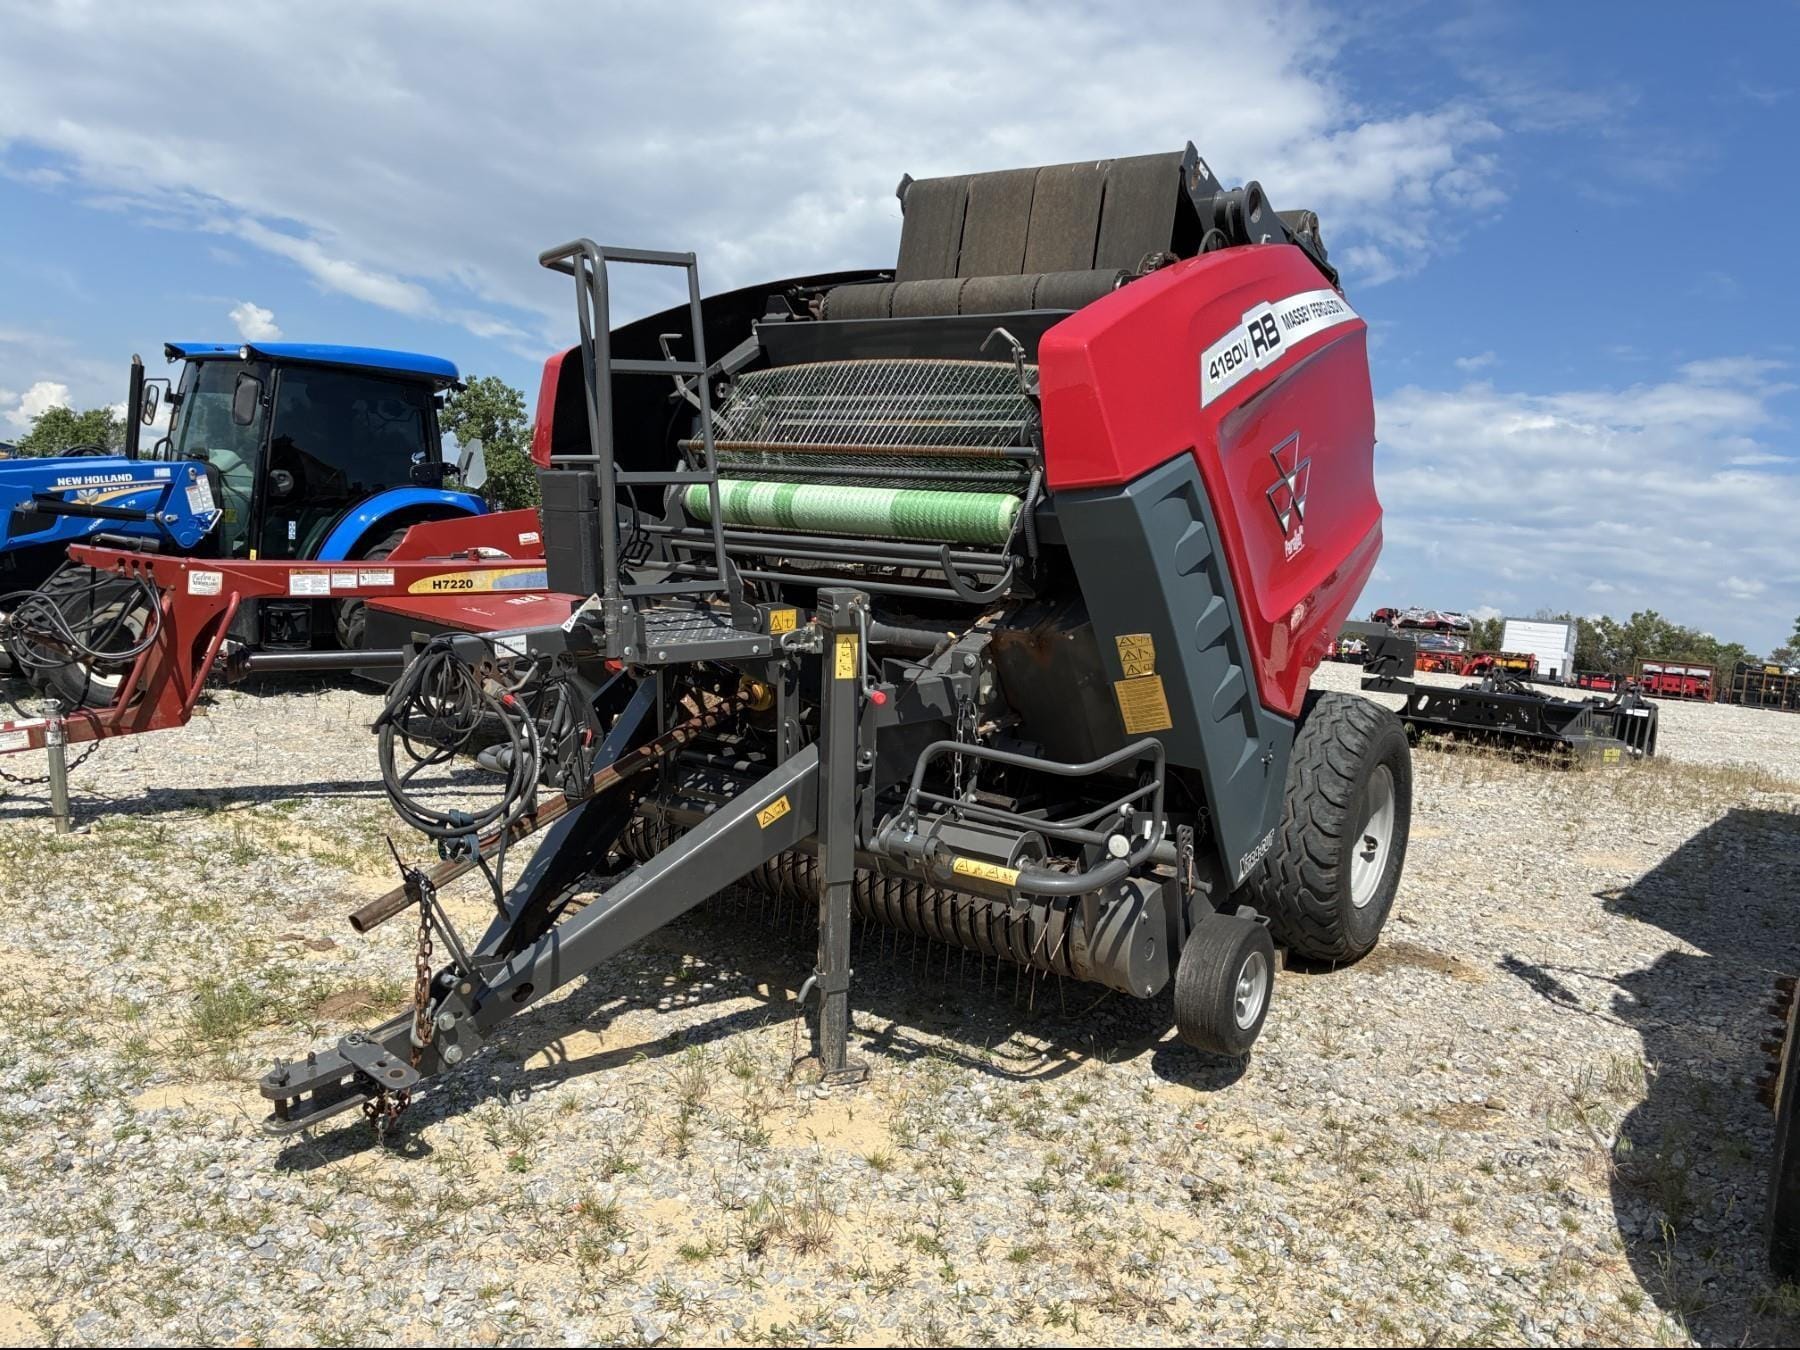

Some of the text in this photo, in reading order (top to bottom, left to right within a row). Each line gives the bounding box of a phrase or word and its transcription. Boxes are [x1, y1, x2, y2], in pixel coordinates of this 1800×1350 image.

[1280, 299, 1344, 330] MASSEY FERGUSON
[1248, 312, 1281, 358] RB
[1209, 339, 1249, 380] 4180V
[57, 473, 133, 486] NEW HOLLAND
[432, 579, 474, 590] H7220
